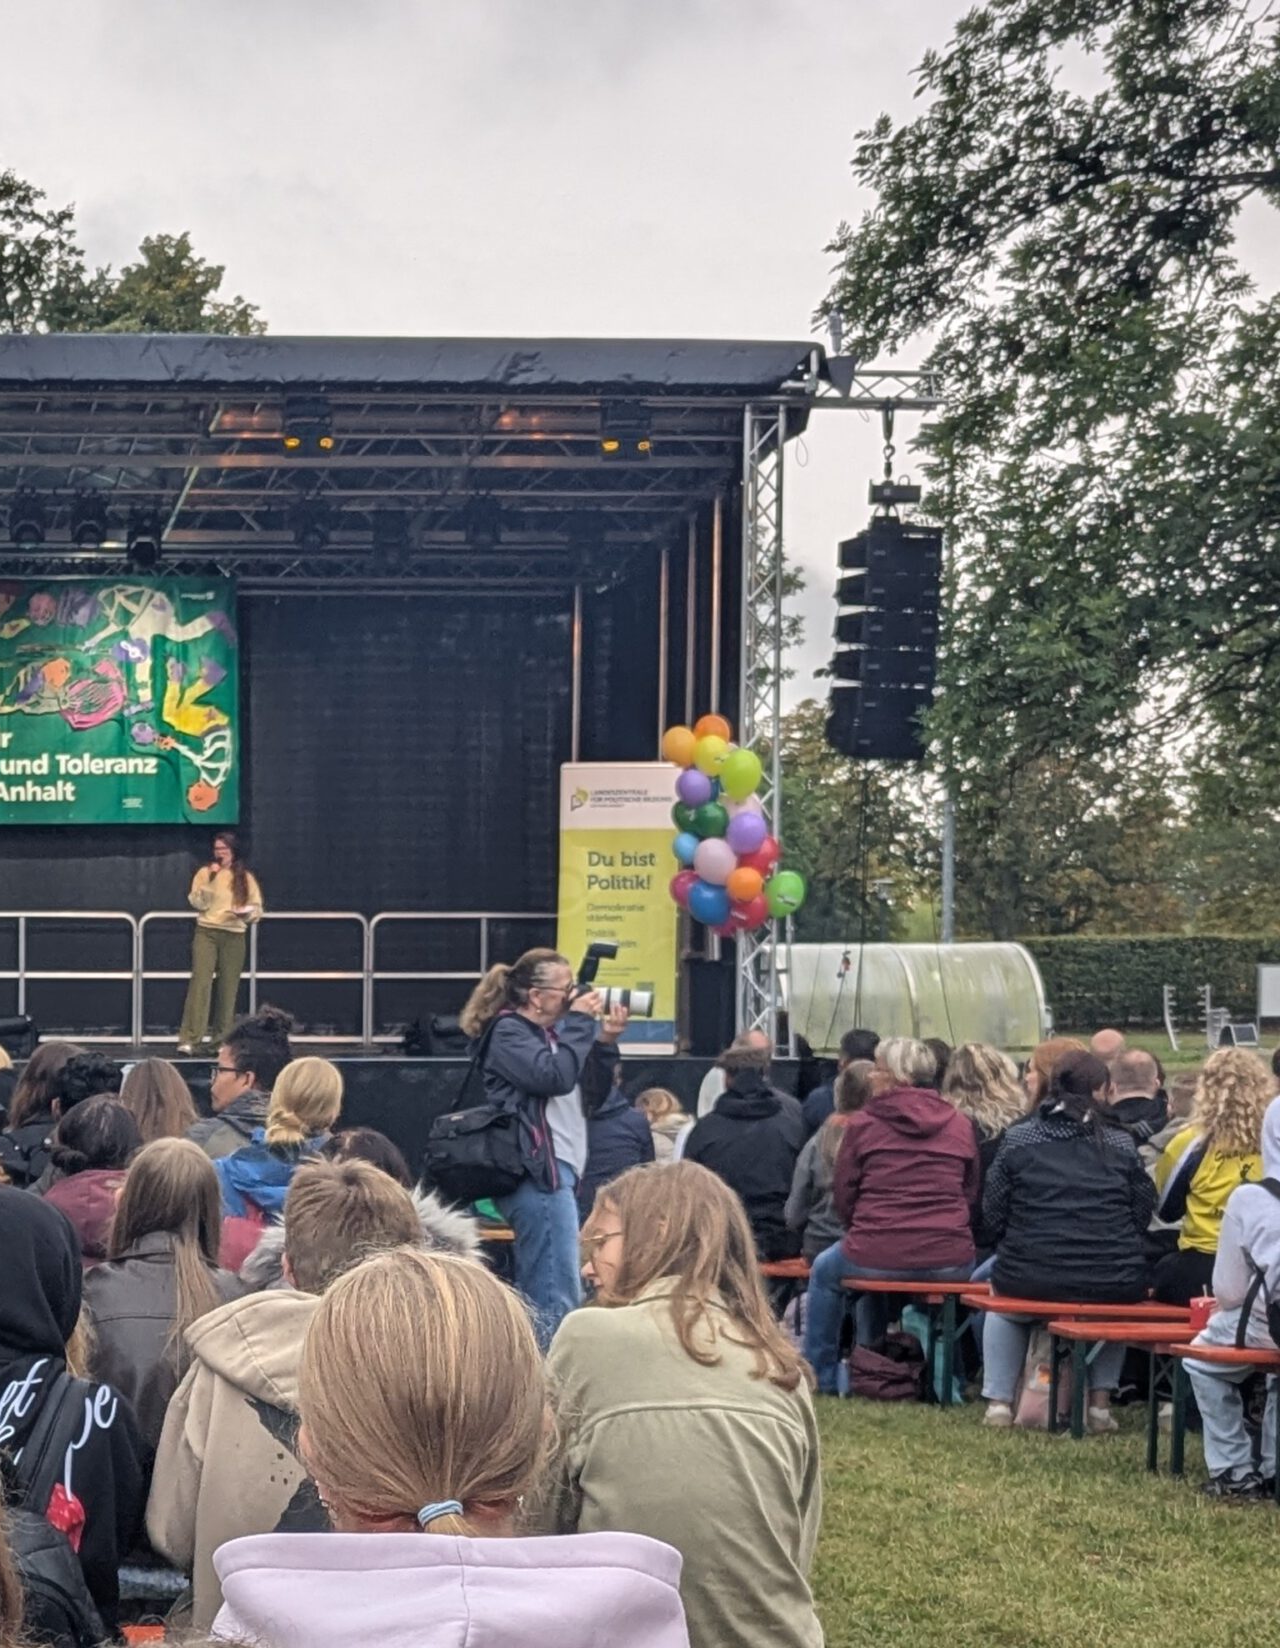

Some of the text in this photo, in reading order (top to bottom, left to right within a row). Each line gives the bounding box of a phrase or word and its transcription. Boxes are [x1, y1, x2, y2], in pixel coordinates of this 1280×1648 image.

[0, 752, 50, 776] und
[55, 752, 158, 775] Toleranz
[587, 851, 656, 867] Du bist
[587, 874, 651, 891] Politik!
